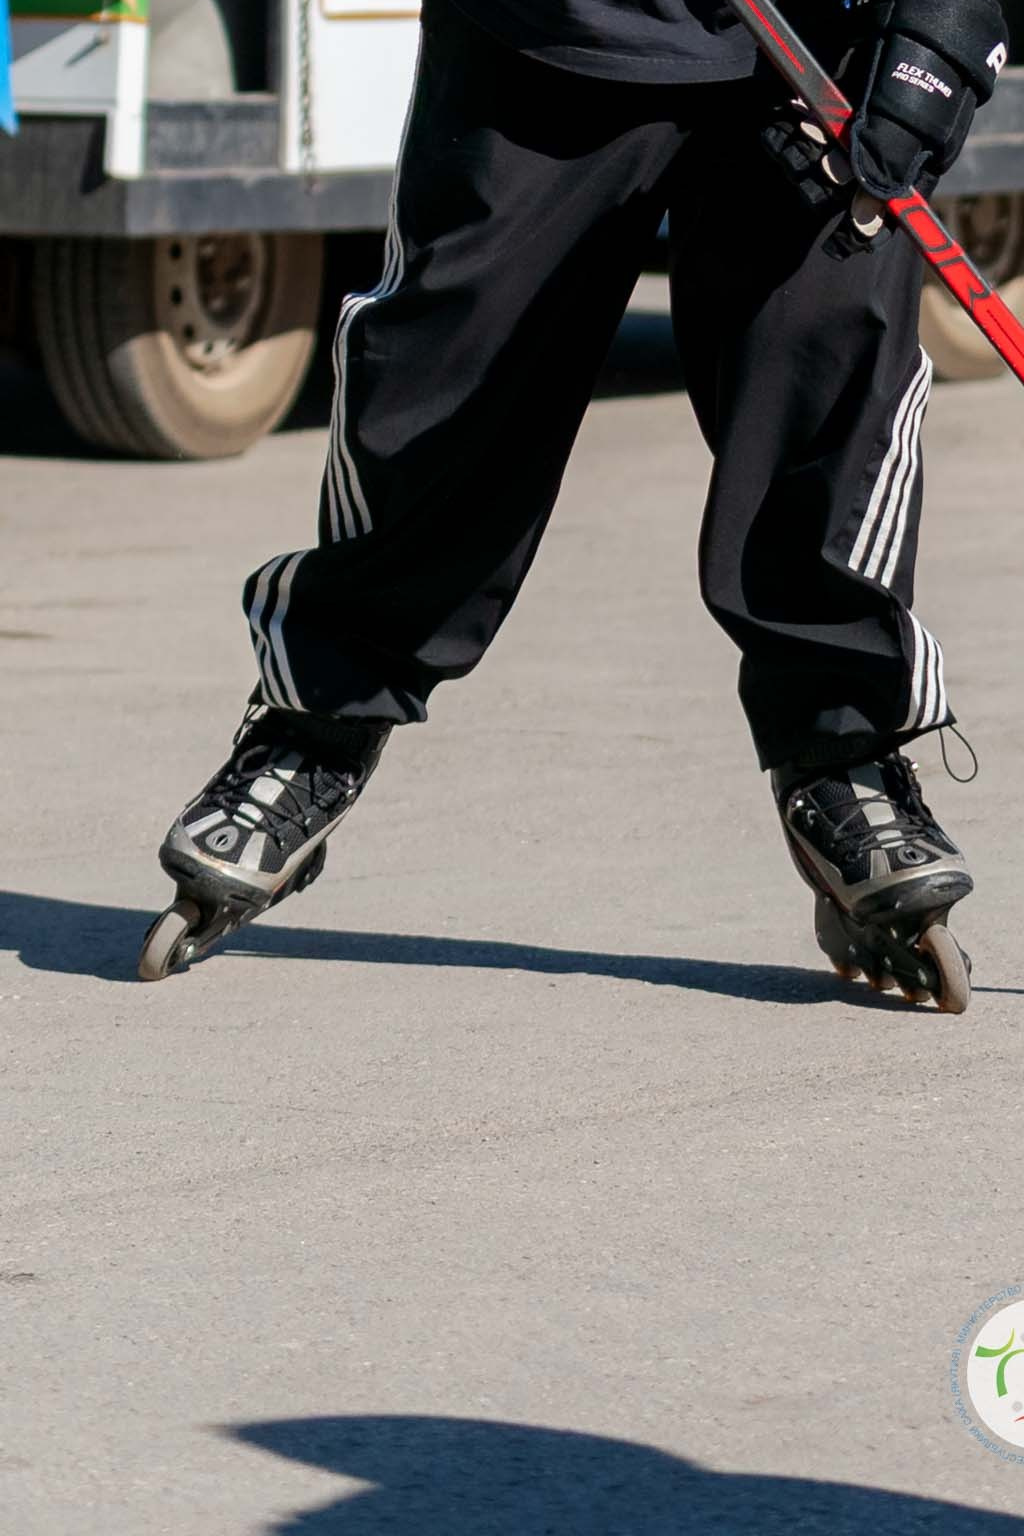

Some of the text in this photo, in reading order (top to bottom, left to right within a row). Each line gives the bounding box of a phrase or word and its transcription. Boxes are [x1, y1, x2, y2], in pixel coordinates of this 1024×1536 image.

[890, 70, 909, 84] PRO
[896, 62, 953, 98] FLEX THUMB
